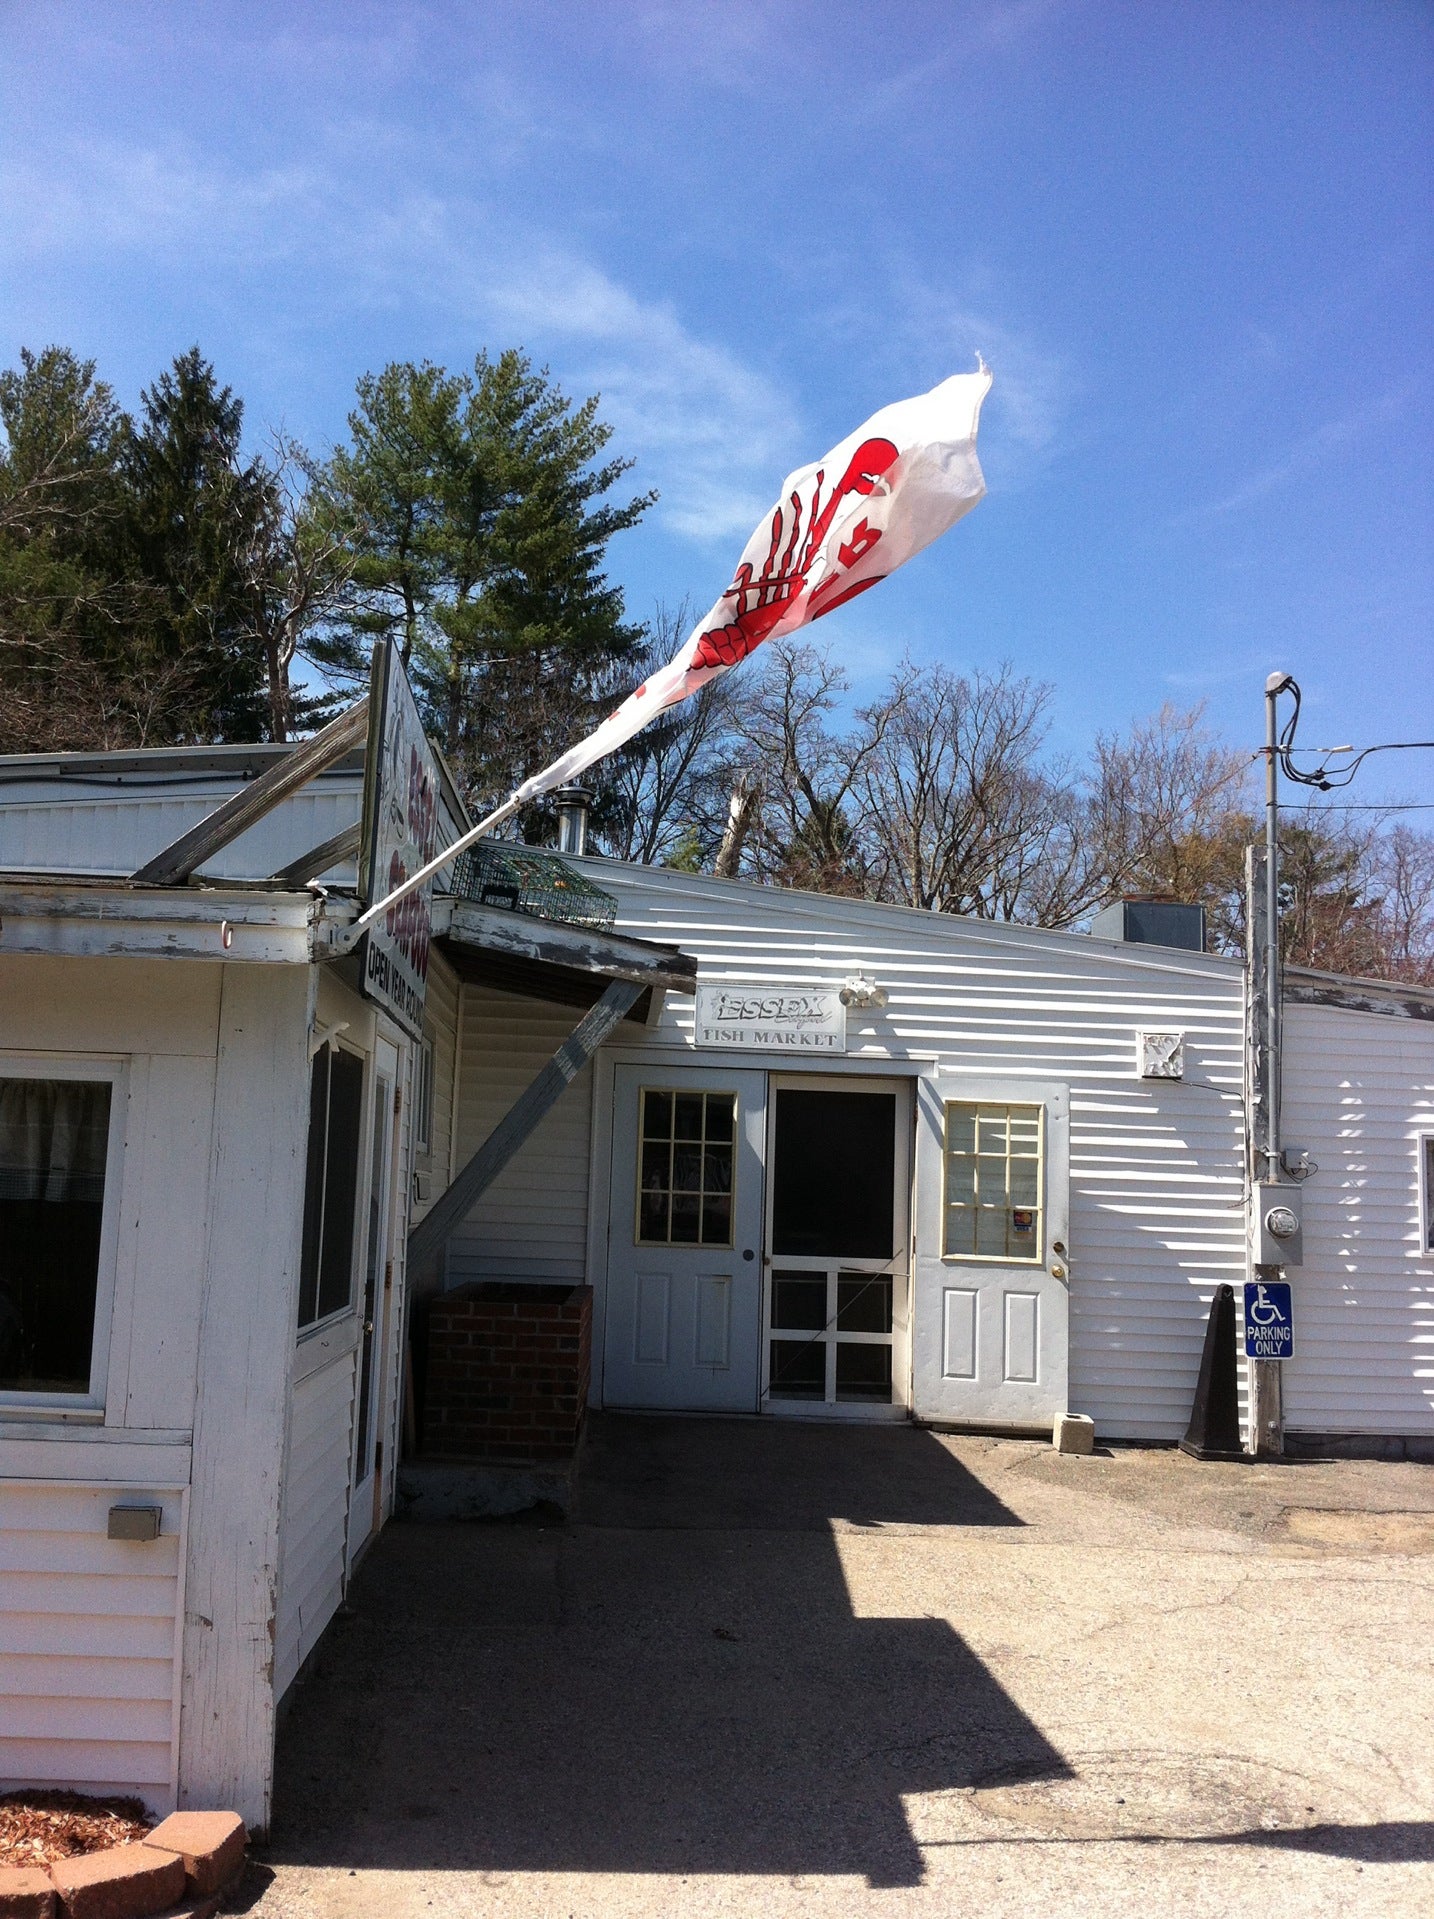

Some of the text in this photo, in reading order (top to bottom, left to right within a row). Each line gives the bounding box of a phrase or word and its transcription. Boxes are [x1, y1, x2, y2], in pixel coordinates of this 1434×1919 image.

[368, 940, 390, 994] OPEN
[391, 964, 406, 1011] YEAR
[716, 996, 827, 1020] ESSEX
[703, 1029, 837, 1046] FISH MARKET
[1247, 1326, 1291, 1341] PARKING
[1255, 1341, 1283, 1355] ONLY
